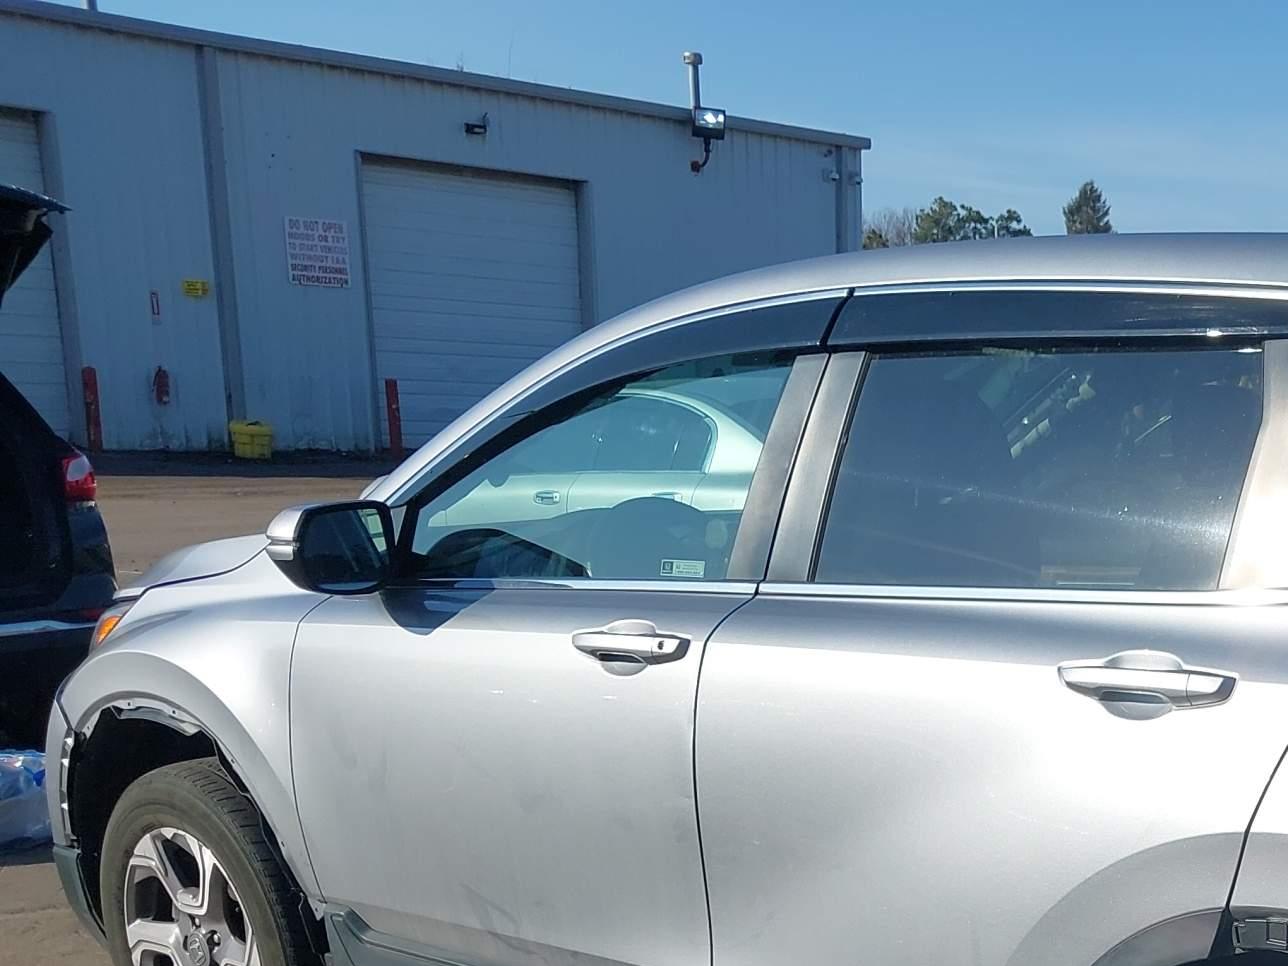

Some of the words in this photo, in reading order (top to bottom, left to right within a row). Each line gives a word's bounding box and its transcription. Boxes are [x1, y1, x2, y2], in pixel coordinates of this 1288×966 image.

[288, 219, 300, 230] DO
[303, 220, 319, 232] NOT
[322, 222, 343, 234] OPEN
[318, 234, 328, 243] OR
[331, 236, 345, 244] TRY
[288, 242, 297, 250] TO
[289, 252, 328, 263] WITHOUT
[291, 273, 349, 285] AUTHORIZATION
